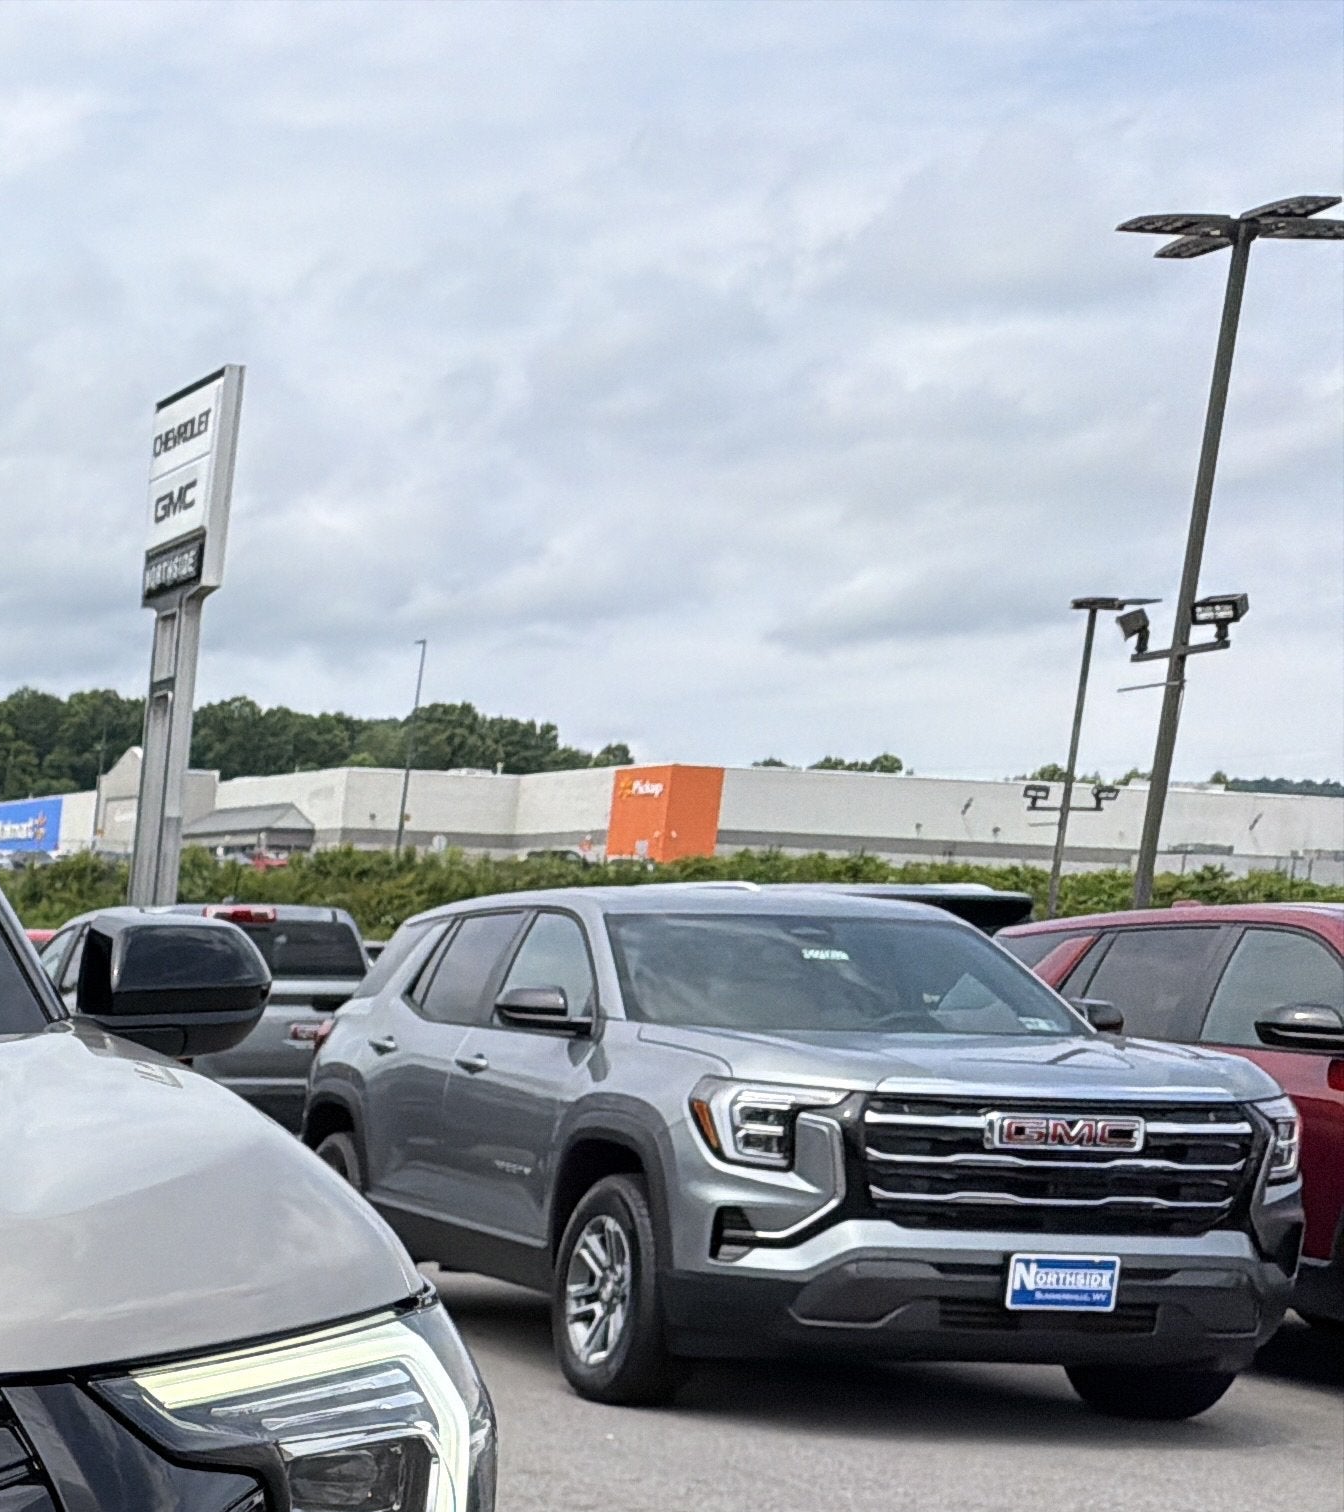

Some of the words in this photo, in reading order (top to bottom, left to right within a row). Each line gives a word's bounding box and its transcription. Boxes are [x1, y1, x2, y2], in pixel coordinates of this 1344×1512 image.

[153, 408, 211, 458] CHEVROLET
[154, 478, 197, 524] GMC
[145, 550, 197, 590] NORTHSIDE
[632, 779, 664, 798] Pickup
[1002, 1117, 1140, 1146] GMC
[1013, 1262, 1111, 1291] NORTHSIDE
